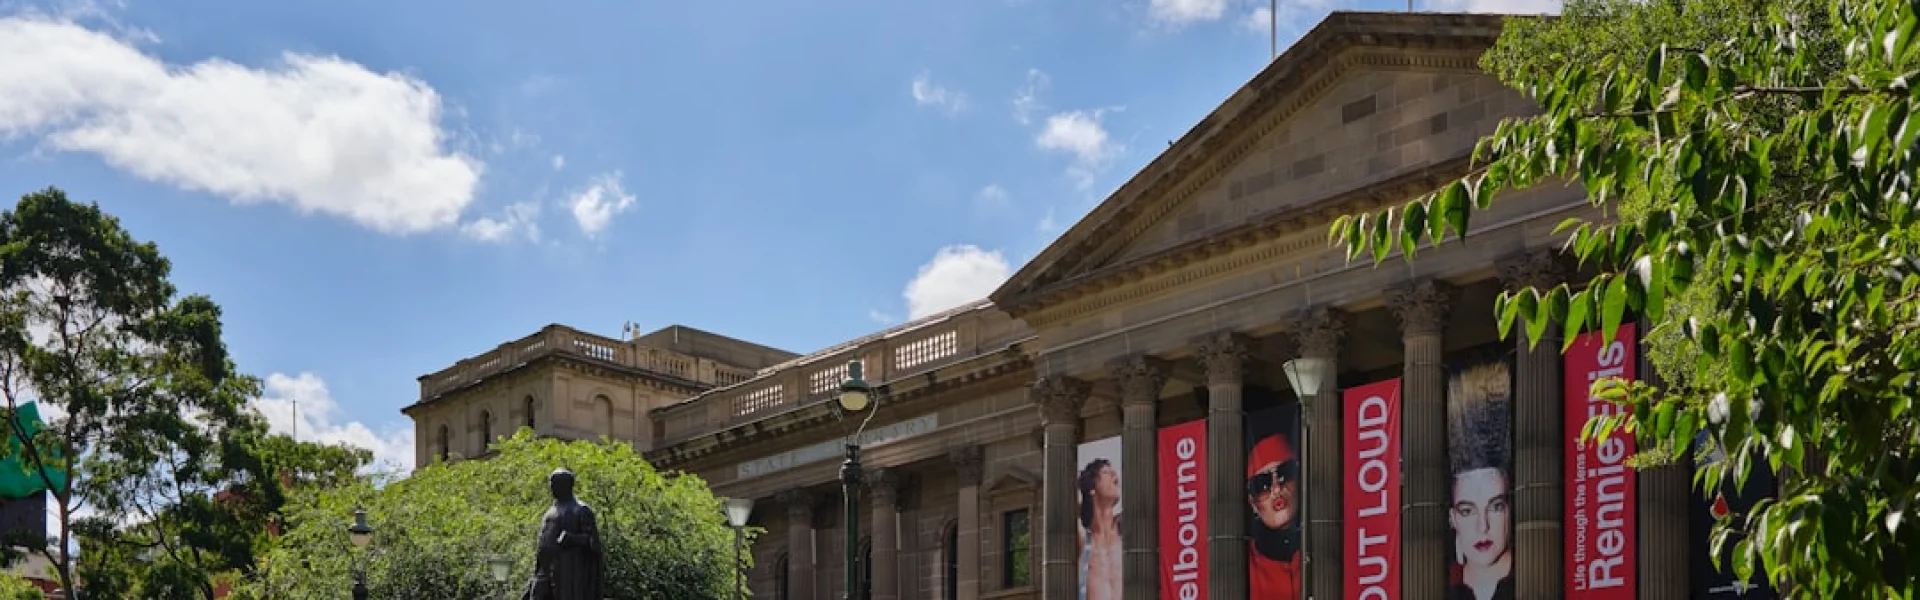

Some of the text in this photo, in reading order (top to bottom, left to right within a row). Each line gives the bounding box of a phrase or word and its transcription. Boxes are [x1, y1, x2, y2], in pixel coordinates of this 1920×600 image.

[742, 451, 797, 476] STATE
[1357, 395, 1389, 518] LOUD
[1574, 453, 1587, 482] lens
[1588, 340, 1626, 590] Rennie Eis
[1574, 484, 1587, 507] the
[1573, 508, 1589, 563] through
[1574, 564, 1587, 591] Life
